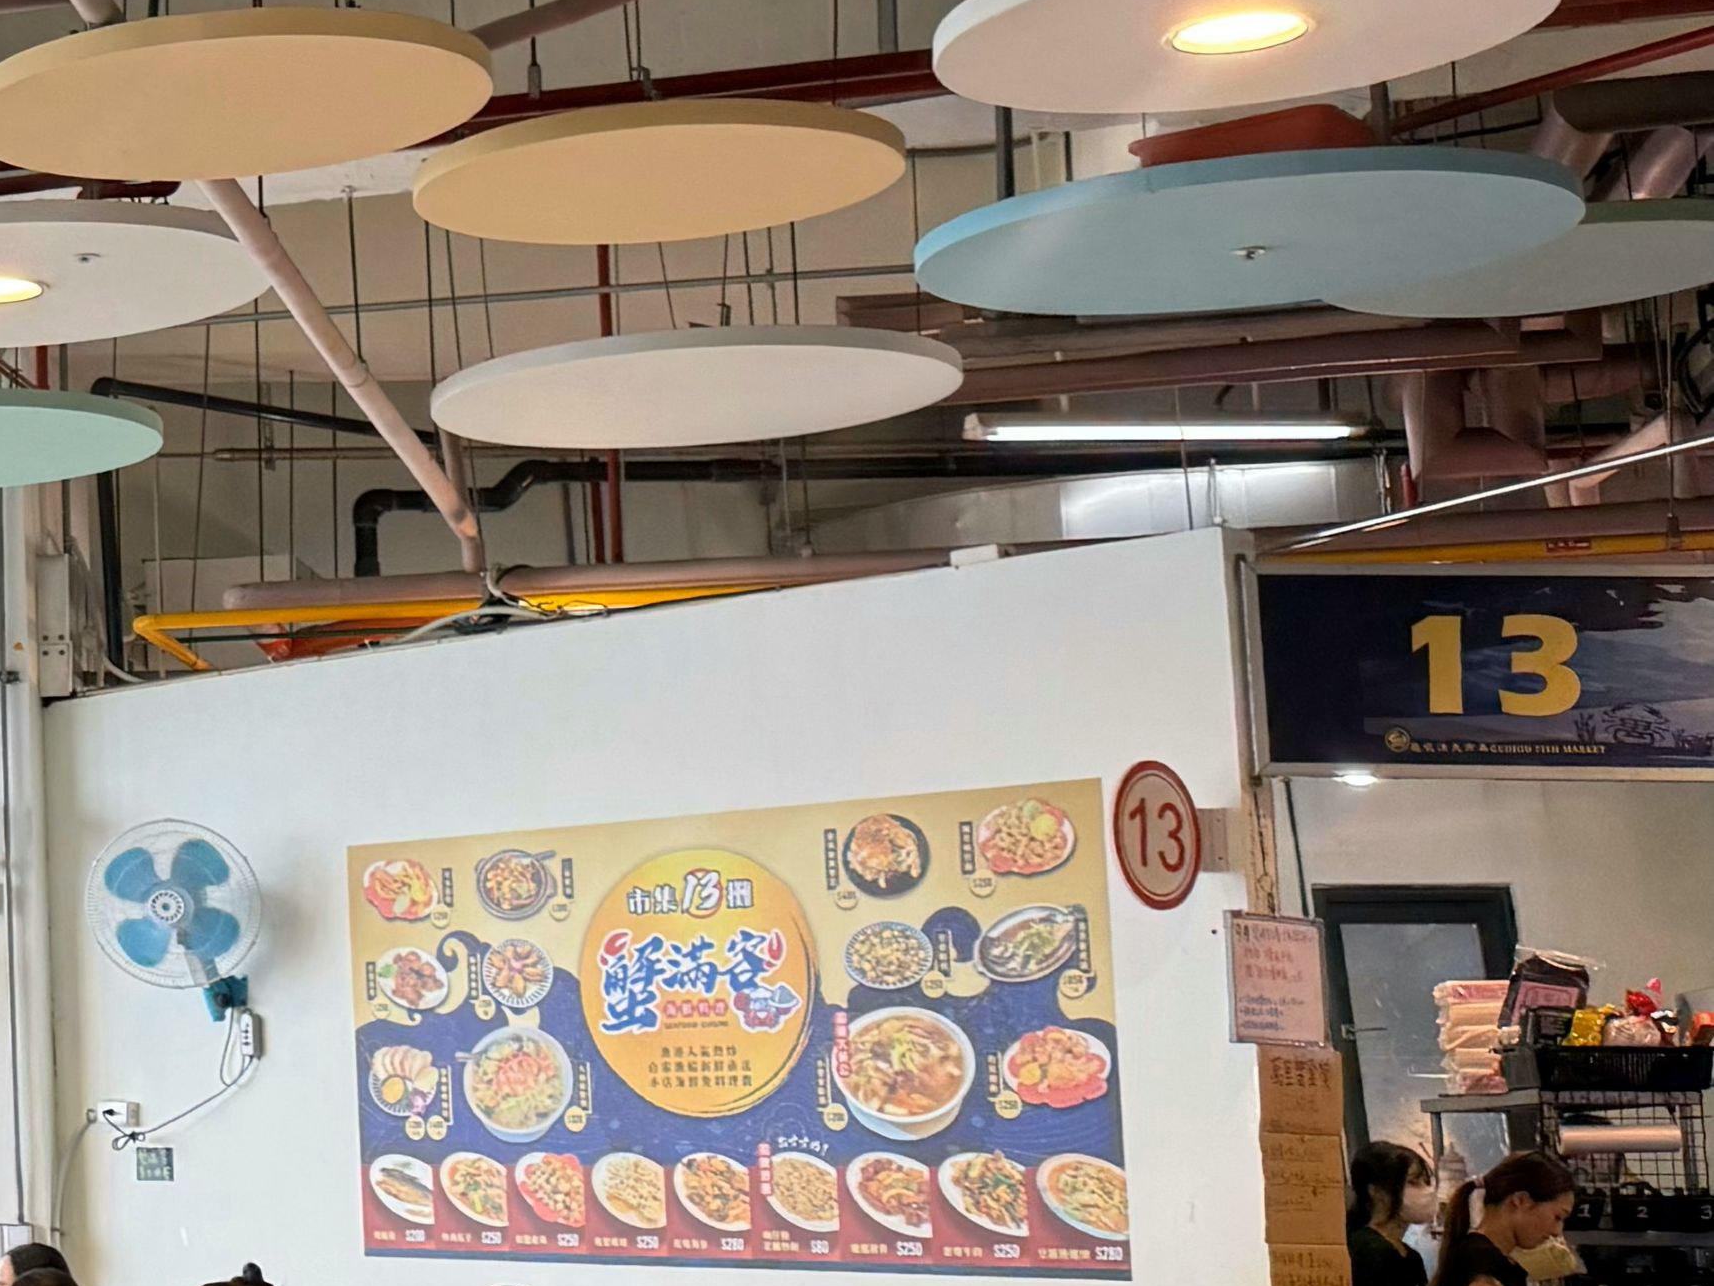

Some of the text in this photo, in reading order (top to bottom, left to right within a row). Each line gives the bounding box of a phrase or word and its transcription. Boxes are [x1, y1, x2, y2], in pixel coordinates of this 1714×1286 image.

[1411, 614, 1582, 716] 13
[1563, 744, 1606, 754] MARKET
[1129, 798, 1185, 873] 13
[1577, 1203, 1591, 1218] 1
[1636, 1206, 1649, 1218] 2
[1700, 1205, 1712, 1220] 3
[896, 1241, 924, 1256] $250
[993, 1243, 1021, 1259] $250
